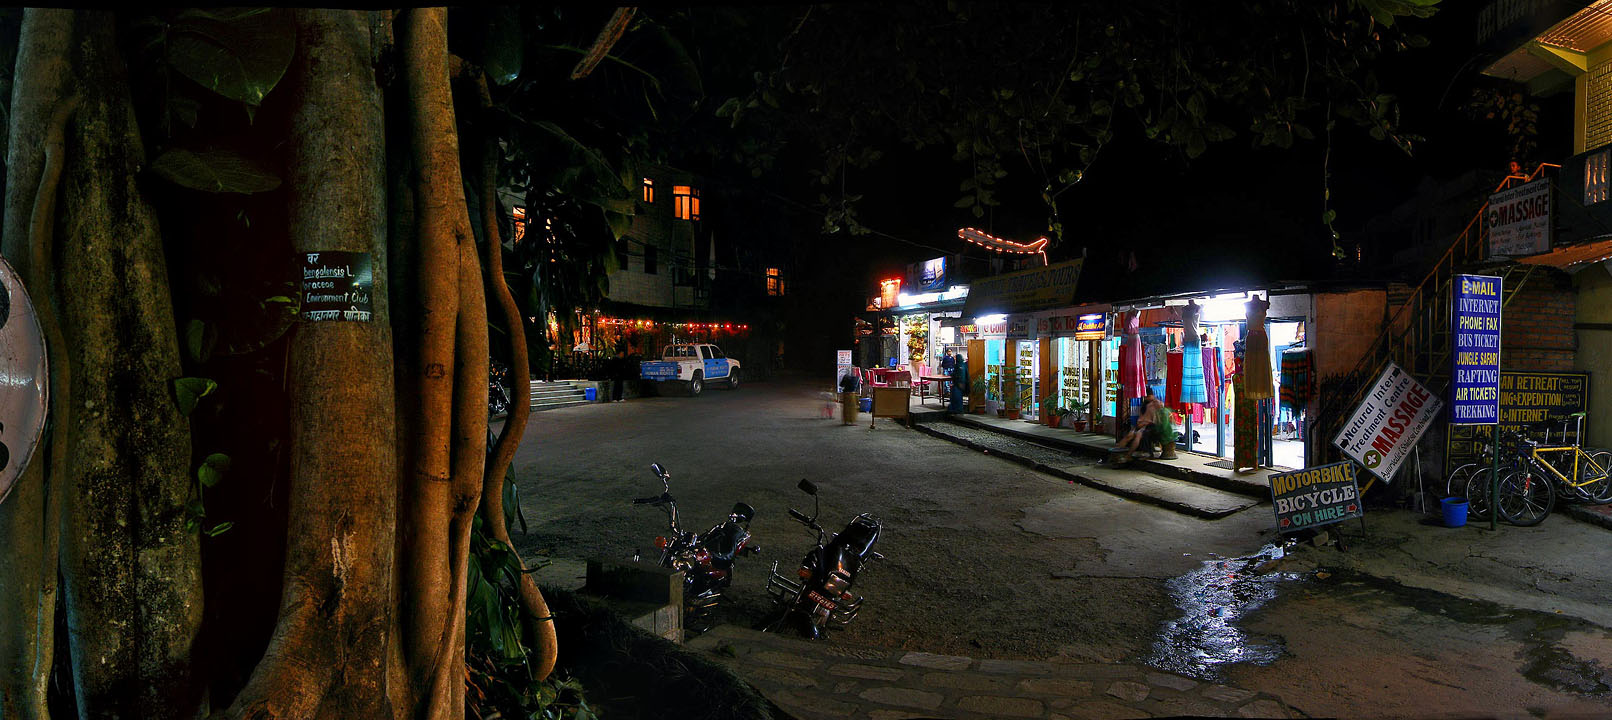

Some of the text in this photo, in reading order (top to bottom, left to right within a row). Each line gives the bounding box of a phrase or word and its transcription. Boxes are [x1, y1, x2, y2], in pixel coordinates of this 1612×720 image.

[1498, 193, 1549, 228] MASSAGE
[304, 264, 356, 280] bengalensis L.
[1462, 281, 1496, 296] E-MAIL
[306, 290, 370, 304] Environment Club
[1459, 298, 1499, 314] INTERNET
[1486, 317, 1498, 331] FAX
[1457, 334, 1498, 348] BUS TICKET
[1457, 352, 1498, 366] JUNGLE SAFARI
[1062, 366, 1080, 377] JUNGLE
[1456, 369, 1497, 384] RAFTING
[1516, 375, 1559, 391] RETREAT
[1455, 388, 1468, 401] AIR
[1470, 387, 1496, 401] TICKETS
[1345, 375, 1394, 442] Natural Inter
[1350, 408, 1386, 454] Treatment
[1384, 378, 1410, 408] Centre
[1455, 405, 1496, 418] TREKKING
[1508, 408, 1550, 423] INTERNET
[1371, 383, 1430, 457] MASSAGE
[1271, 463, 1354, 496] MOTORBIKE
[1276, 485, 1356, 514] BICYCLE
[1292, 505, 1345, 526] ON HIRE
